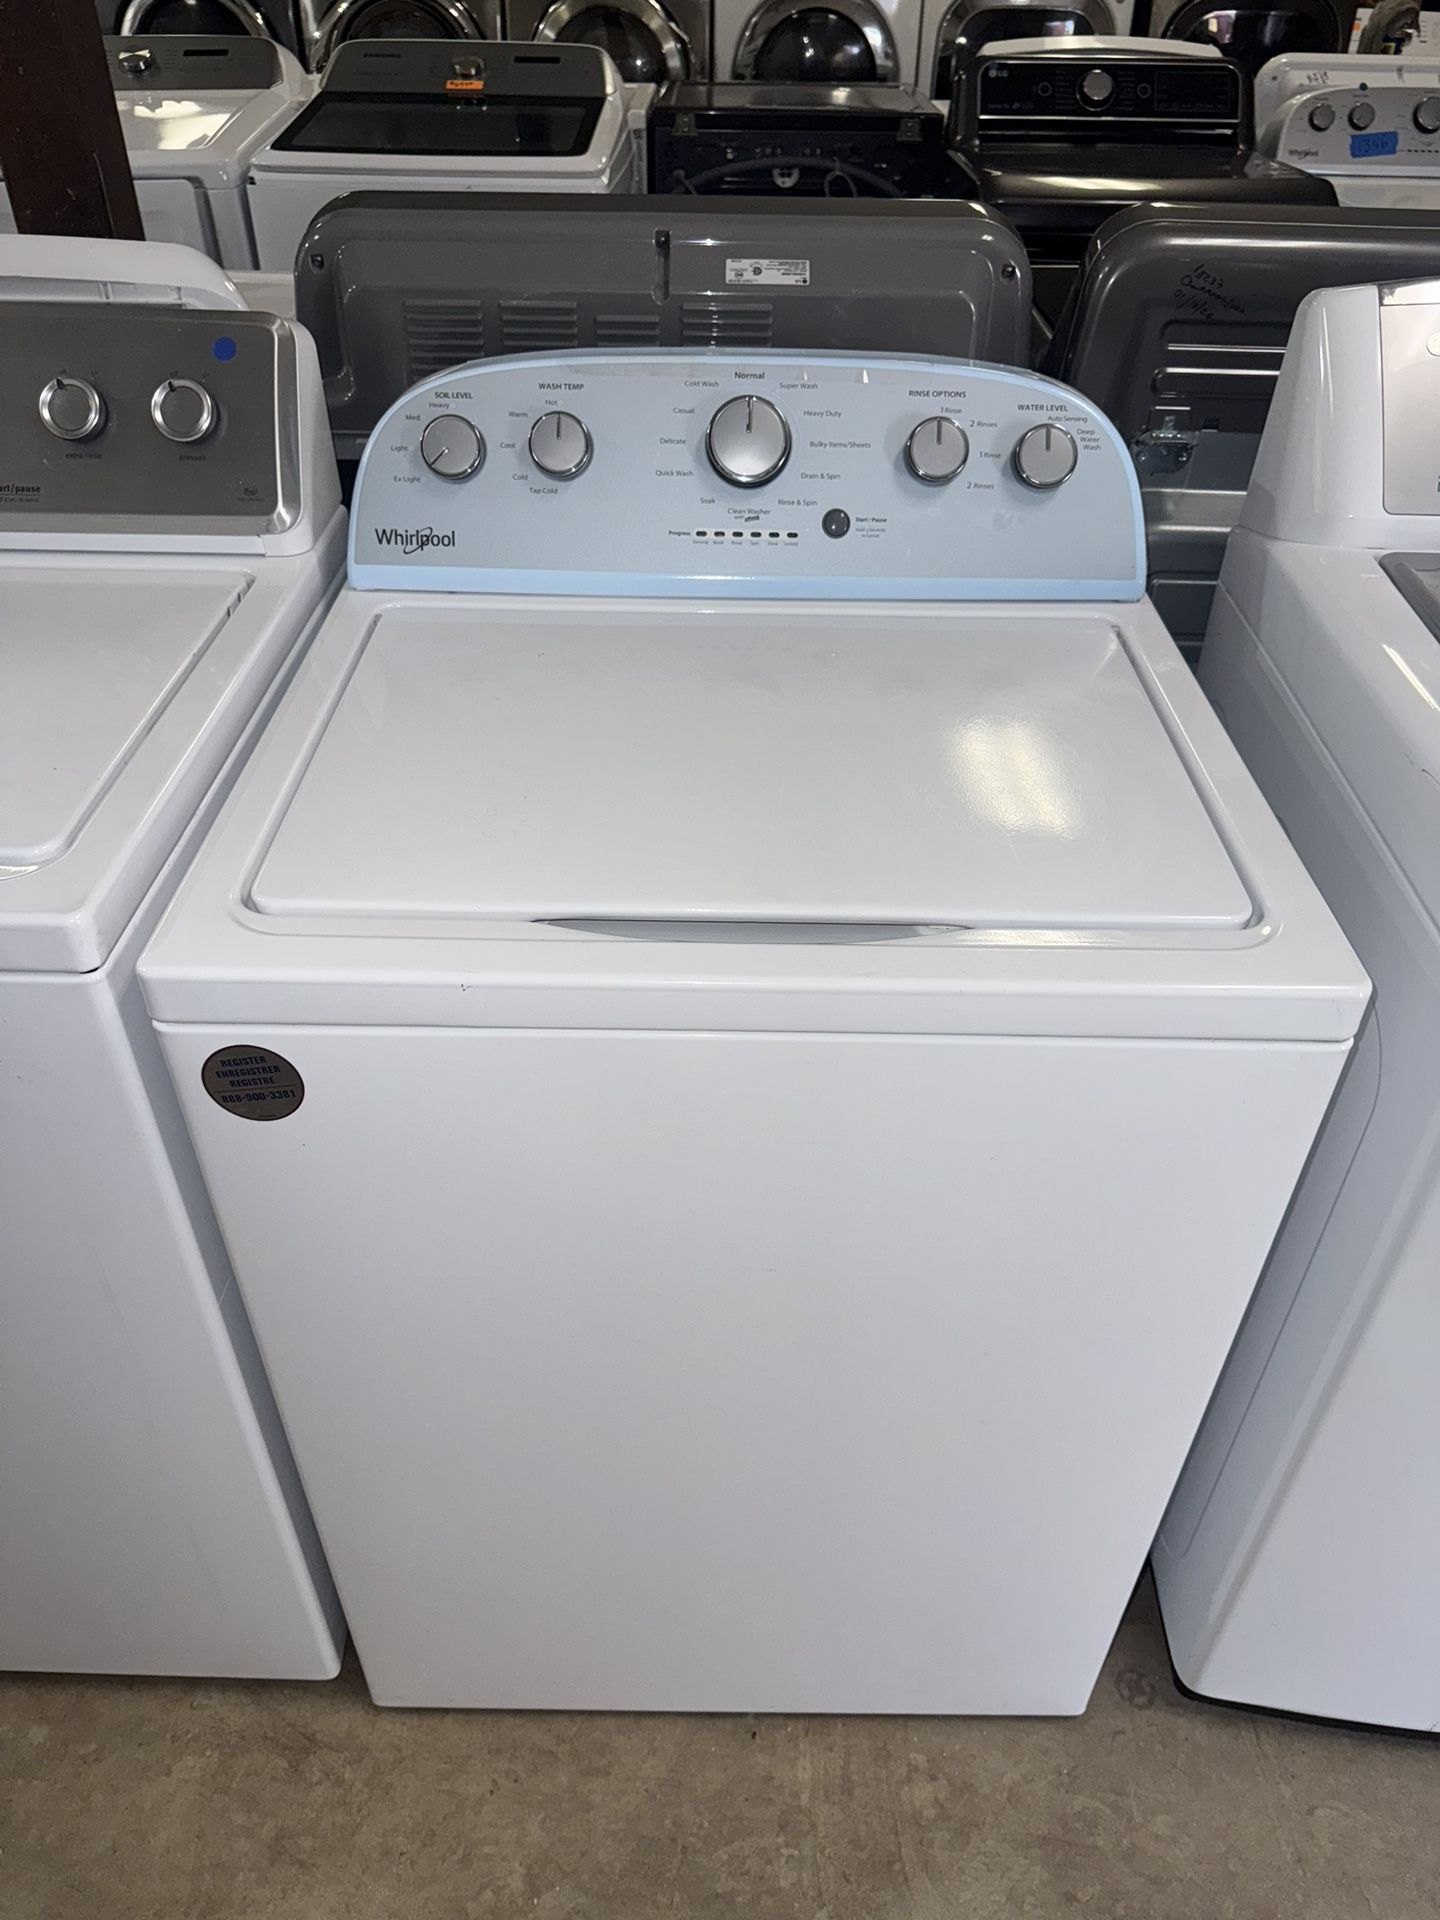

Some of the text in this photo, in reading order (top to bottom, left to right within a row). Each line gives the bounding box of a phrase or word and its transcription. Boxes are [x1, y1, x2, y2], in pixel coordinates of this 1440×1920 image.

[734, 371, 765, 380] Normal
[563, 383, 584, 391] TEMP
[684, 380, 719, 388] Cold Wash
[779, 382, 798, 391] Super
[452, 392, 473, 400] LEVEL
[909, 390, 967, 399] RINSE OPTIONS
[429, 401, 450, 409] Heavy
[1018, 404, 1069, 412] WATER LEVEL
[507, 410, 528, 418] Warm
[803, 410, 842, 418] Heavy Duty
[1063, 416, 1088, 424] Sensing
[1077, 428, 1095, 436] Deep
[659, 437, 686, 445] Delicate
[810, 441, 871, 449] Bulky Items/Sheets
[390, 445, 408, 453] Light
[512, 473, 528, 481] Cold
[655, 470, 673, 478] Quick
[826, 473, 841, 481] Spin
[403, 475, 421, 483] Light
[973, 482, 994, 490] Rinses
[529, 487, 558, 496] Tap Cold
[803, 499, 818, 507] Spin
[374, 526, 456, 554] Whirlpool
[220, 1056, 267, 1068] REGISTER
[216, 1065, 281, 1079] ENREGISTRER
[230, 1077, 276, 1088] REGISTRE
